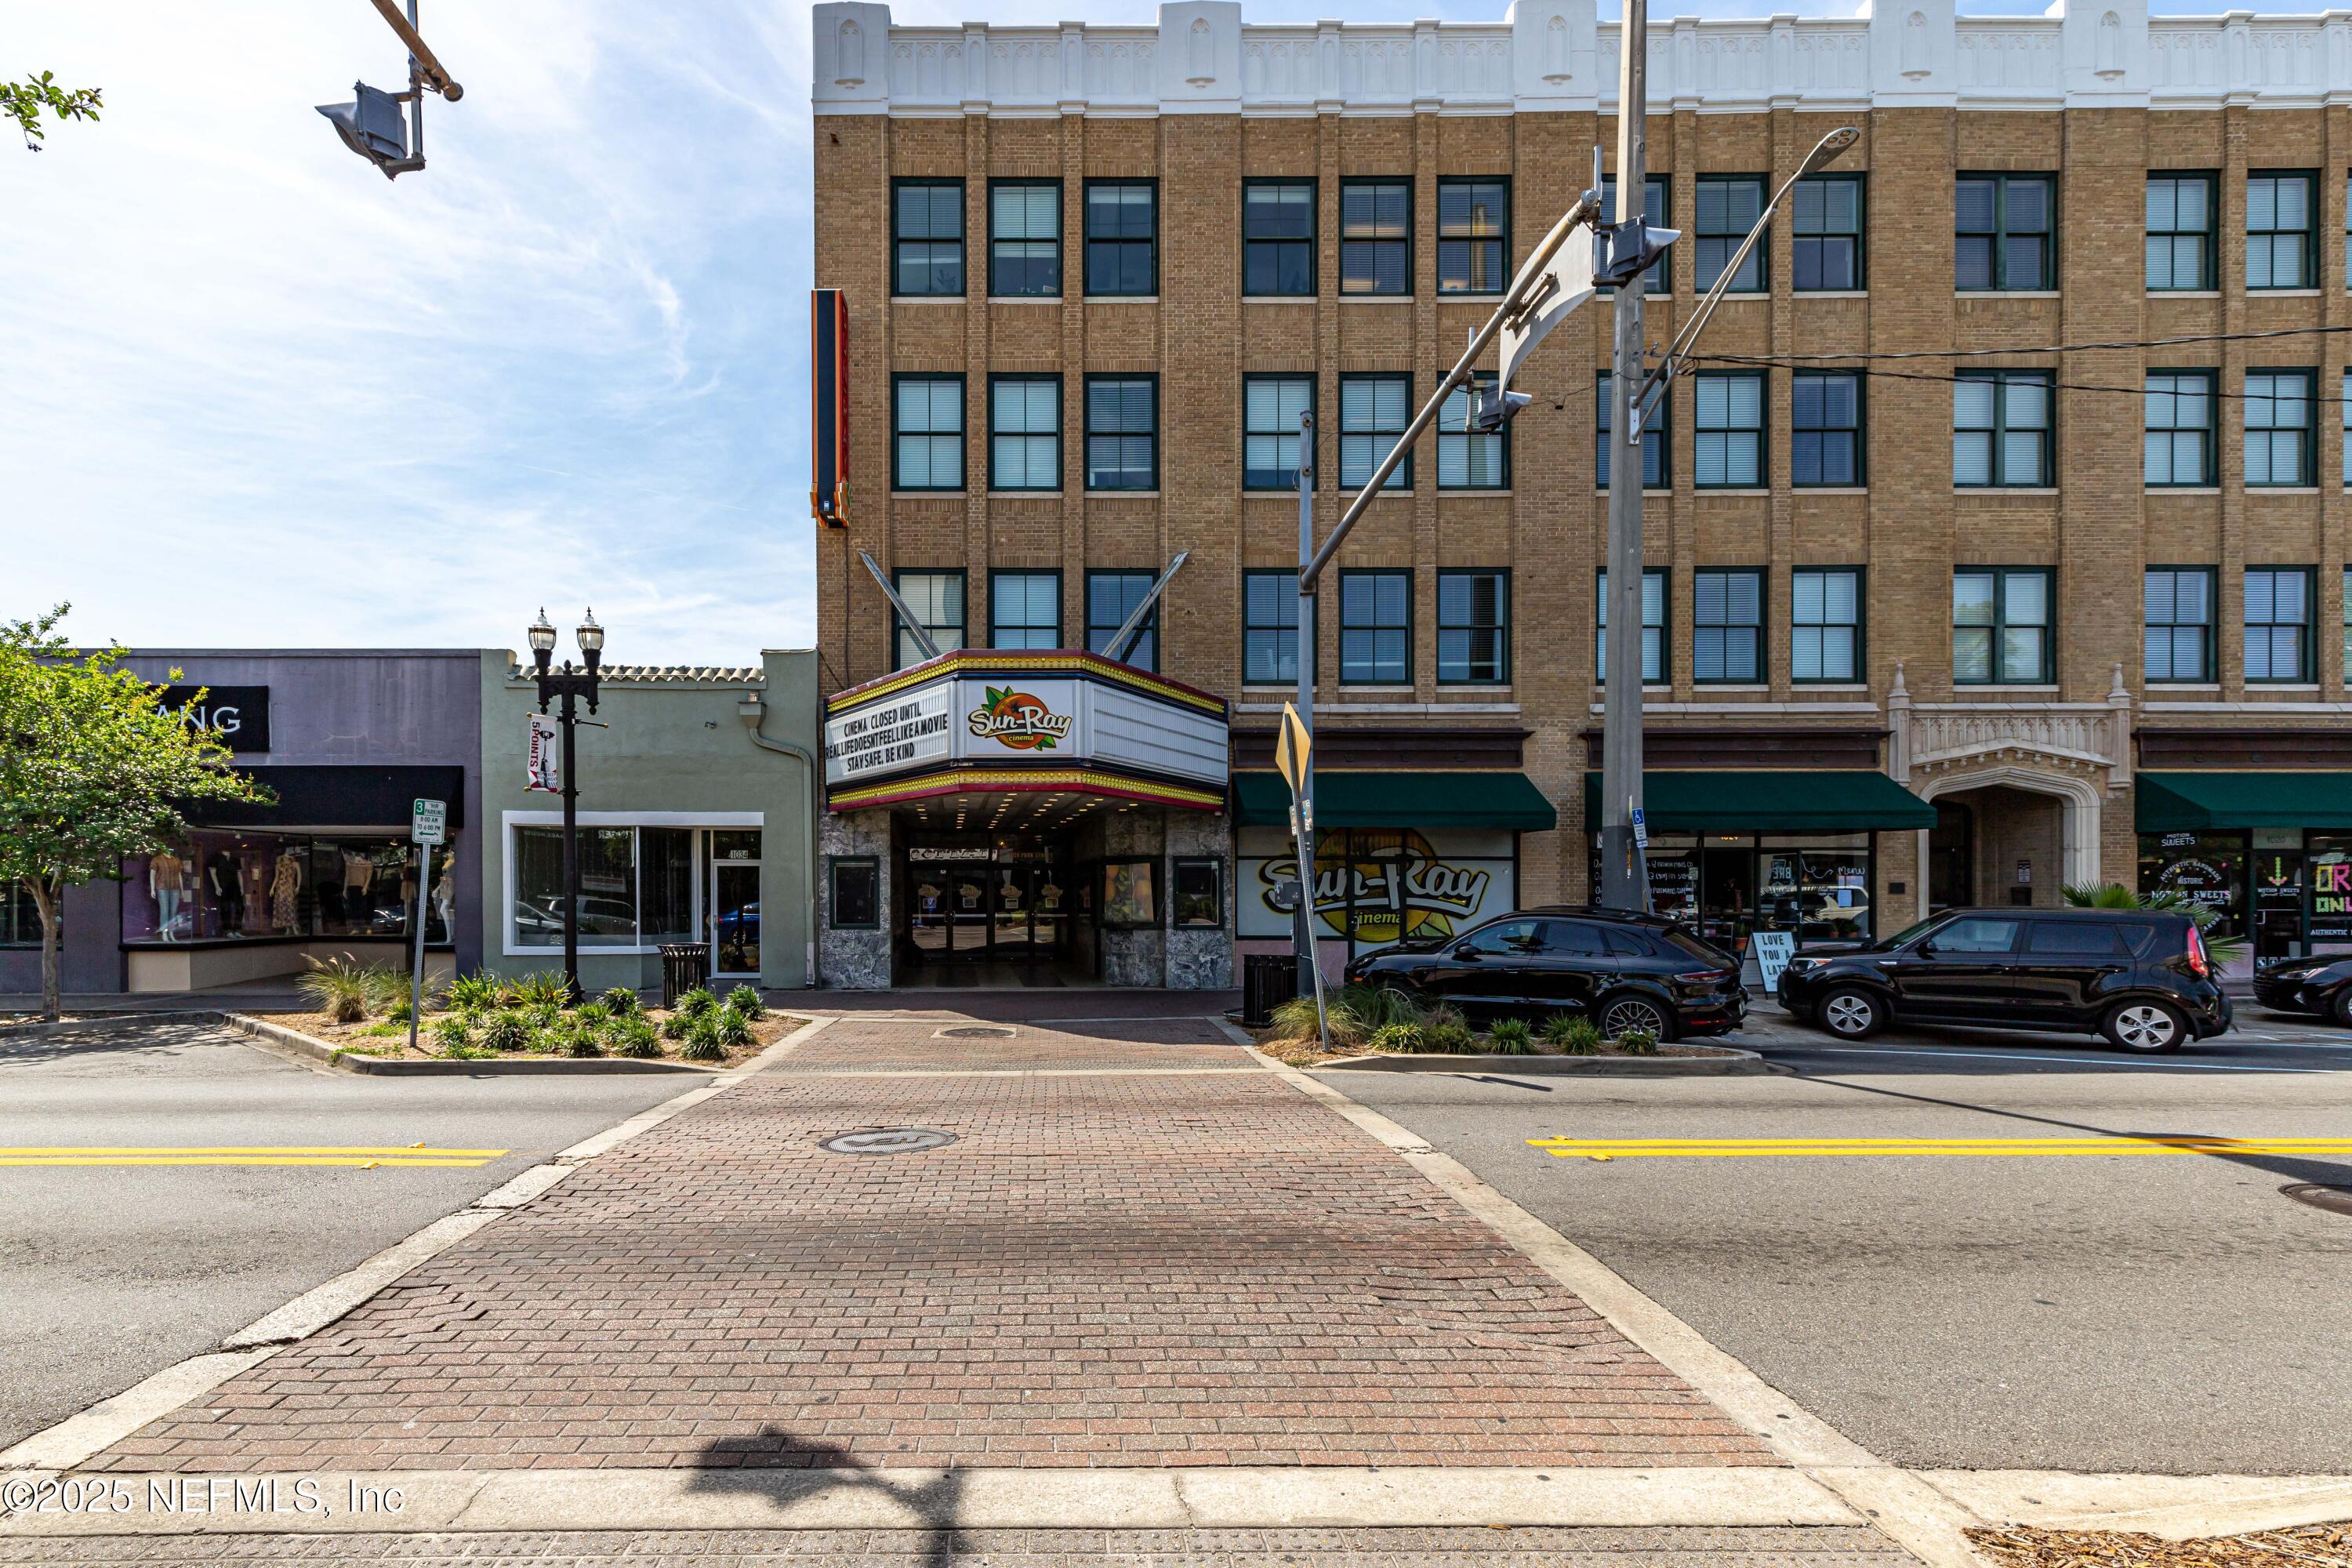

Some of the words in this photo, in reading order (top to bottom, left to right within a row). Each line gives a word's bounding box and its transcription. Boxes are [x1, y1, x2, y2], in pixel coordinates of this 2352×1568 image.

[844, 717, 867, 738] CINEMA
[870, 709, 898, 730] CLOSED
[899, 702, 921, 721] UNTIL
[969, 706, 1073, 739] Sun-Ray
[848, 753, 866, 771] STAY
[885, 746, 895, 764] BE
[896, 742, 915, 761] KIND
[416, 802, 423, 812] 3
[2161, 837, 2195, 847] SWEETS
[2193, 891, 2231, 899] SWEETS
[1762, 934, 1784, 946] LOVE
[1762, 949, 1780, 960] YOU
[1785, 949, 1791, 960] A
